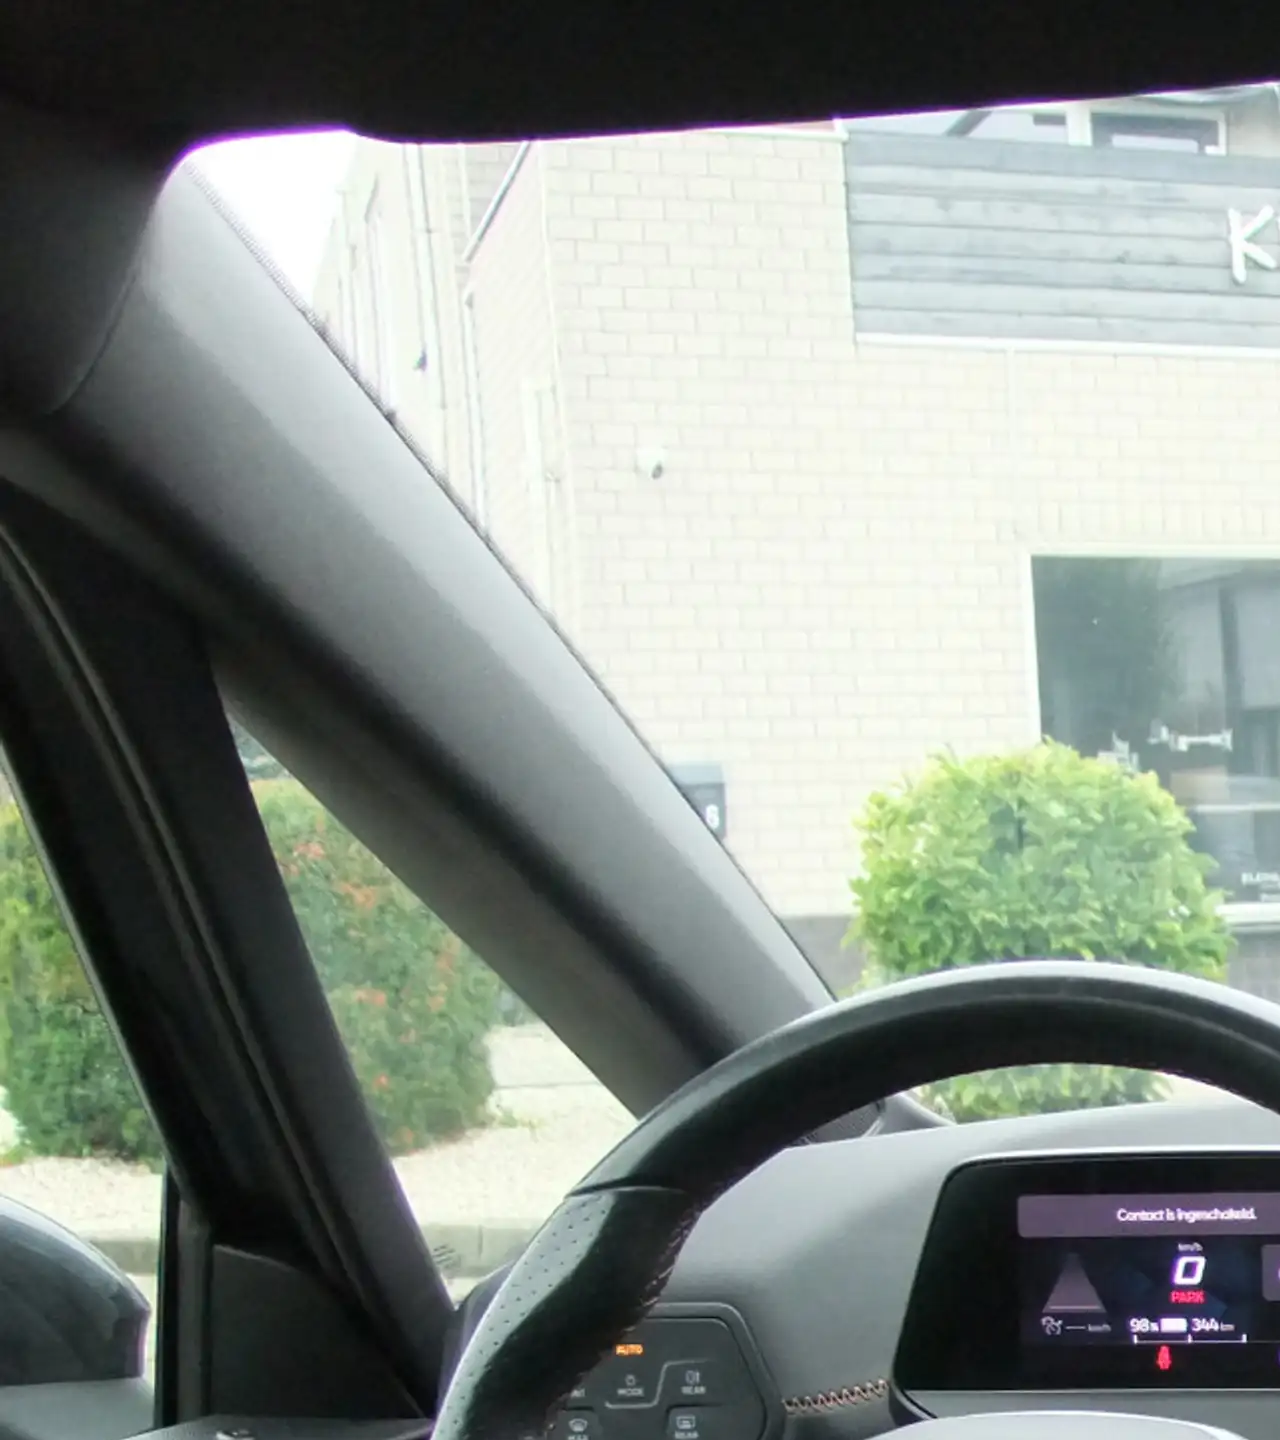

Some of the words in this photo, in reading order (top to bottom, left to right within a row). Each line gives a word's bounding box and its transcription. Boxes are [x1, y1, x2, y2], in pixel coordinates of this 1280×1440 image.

[1116, 1208, 1164, 1222] Contact
[1166, 1208, 1176, 1221] is
[1172, 1256, 1207, 1286] 0
[1169, 1290, 1205, 1304] PARK
